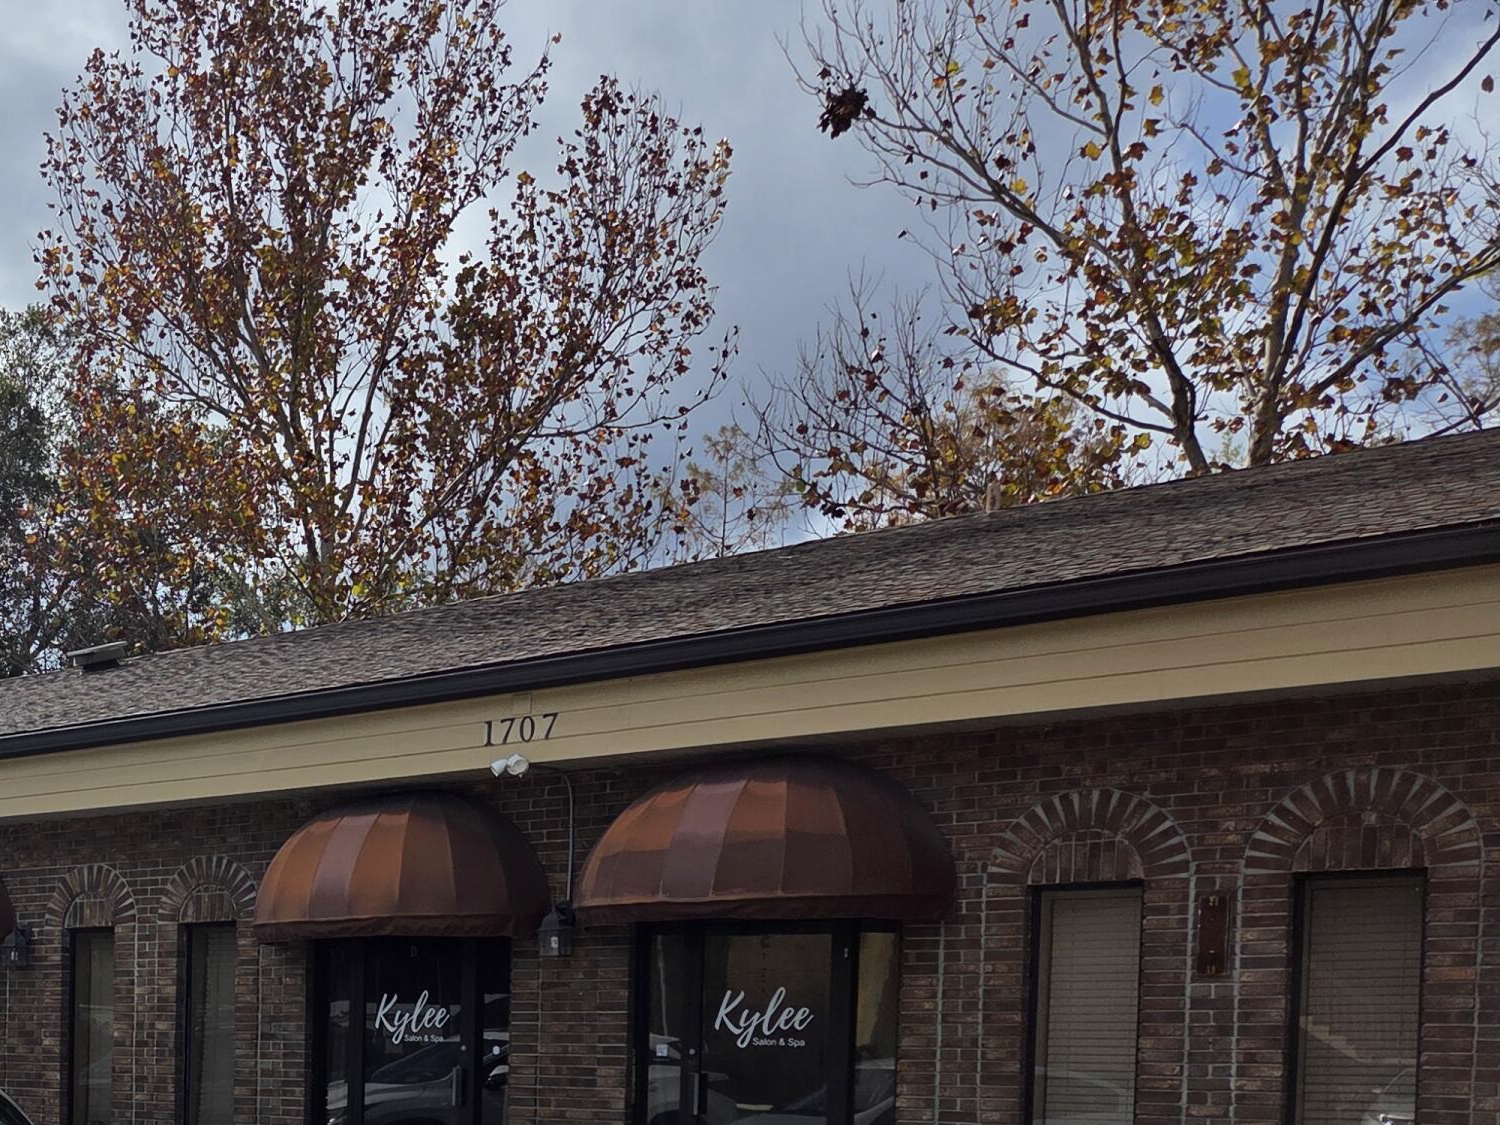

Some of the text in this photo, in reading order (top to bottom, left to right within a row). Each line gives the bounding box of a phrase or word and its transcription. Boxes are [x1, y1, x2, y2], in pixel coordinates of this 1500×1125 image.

[484, 712, 559, 747] 1707
[374, 989, 450, 1045] Kylee
[714, 986, 815, 1049] Kylee
[404, 1034, 422, 1042] Salon
[752, 1038, 806, 1048] Salon & Spa
